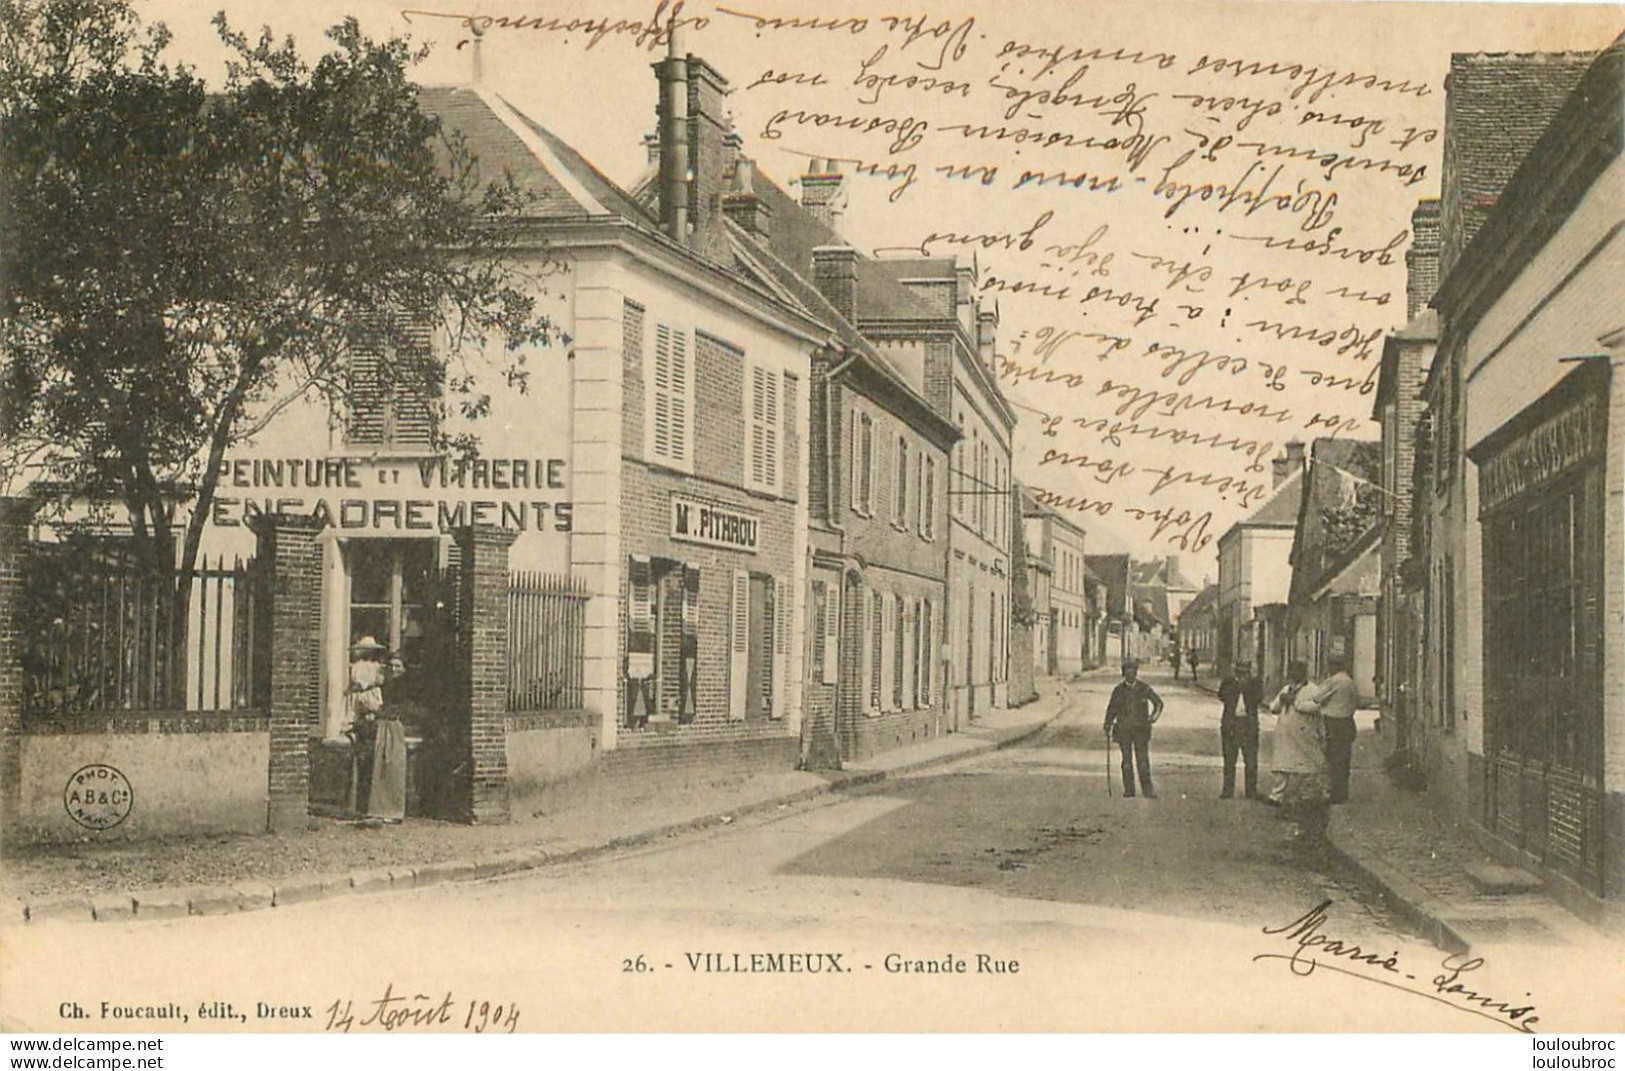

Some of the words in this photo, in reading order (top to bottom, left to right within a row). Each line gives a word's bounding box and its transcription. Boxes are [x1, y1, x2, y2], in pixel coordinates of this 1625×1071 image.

[720, 7, 868, 38] amie
[880, 15, 975, 71] Votre
[745, 69, 828, 91] nos
[853, 44, 971, 104] recevez
[1187, 55, 1431, 105] meilleures
[1173, 94, 1282, 131] chère
[937, 119, 1170, 172] Monsieur
[1184, 129, 1233, 162] de
[1391, 127, 1437, 151] et
[936, 165, 999, 187] au
[1237, 142, 1427, 186] souvenir
[890, 212, 1053, 259] grand
[1041, 227, 1116, 279] déjà
[1229, 227, 1408, 269] garçon
[1132, 252, 1213, 294] être
[1229, 272, 1313, 304] doit
[1078, 286, 1159, 327] trois
[1323, 285, 1392, 306] on
[1170, 303, 1204, 328] à
[1081, 333, 1131, 356] de
[1146, 342, 1246, 388] celles
[1258, 361, 1286, 391] de
[1299, 364, 1380, 397] que
[1097, 380, 1293, 427] nouvelles
[1071, 415, 1273, 472] demander
[217, 458, 364, 489] PEINTURE
[378, 469, 400, 484] ET
[415, 459, 566, 490] VITRERIE
[1142, 469, 1266, 508] vient
[212, 498, 573, 531] ENCADREMENTS
[465, 1000, 521, 1033] 1904
